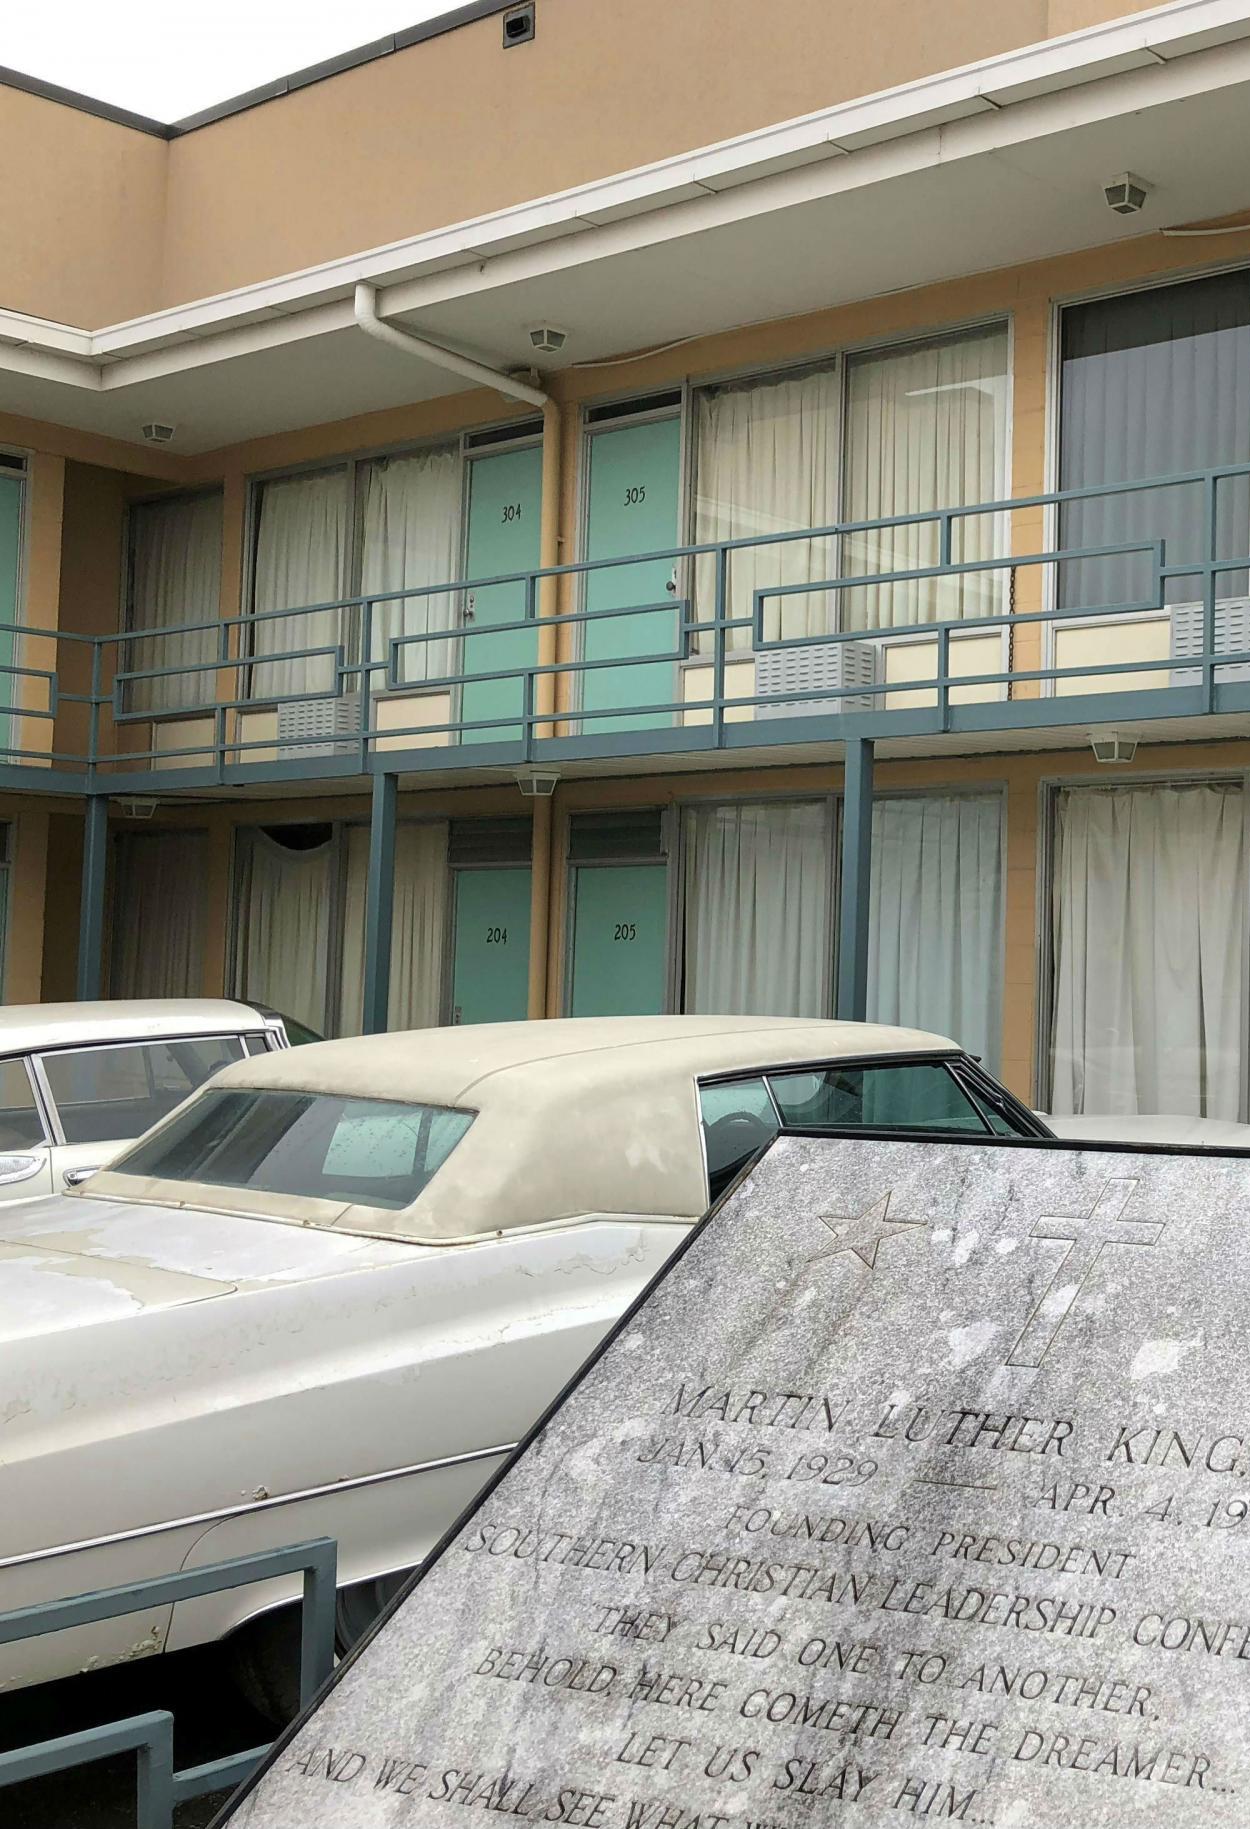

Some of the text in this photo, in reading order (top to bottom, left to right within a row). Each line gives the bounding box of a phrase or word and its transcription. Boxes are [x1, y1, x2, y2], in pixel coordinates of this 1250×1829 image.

[501, 503, 522, 523] 304
[623, 486, 646, 507] 305
[486, 927, 508, 945] 204
[614, 923, 637, 941] 205
[660, 1383, 850, 1432] MARTIN
[869, 1404, 1074, 1457] LUTHER
[785, 1453, 878, 1487] 1929
[1034, 1482, 1124, 1516] APR.
[725, 1505, 1136, 1579] FOUNDING PRESIDENT
[464, 1524, 667, 1577] SOUTHERN
[672, 1552, 874, 1604] CHRISTIAN
[881, 1582, 1117, 1638] LEADERSHIP
[699, 1622, 781, 1659] SAID
[797, 1638, 880, 1674] ONE
[897, 1653, 948, 1684] TO
[960, 1665, 1160, 1721] ANOTHER,
[473, 1649, 1236, 1794] BEHOLD, HERE COMETH THE DREAMER...
[286, 1748, 366, 1783] AND
[373, 1758, 427, 1795] WE
[428, 1768, 535, 1817] SHALL
[544, 1785, 616, 1829] SEE
[614, 1731, 691, 1770] LET
[704, 1746, 761, 1782] US
[773, 1758, 879, 1802] SLAY
